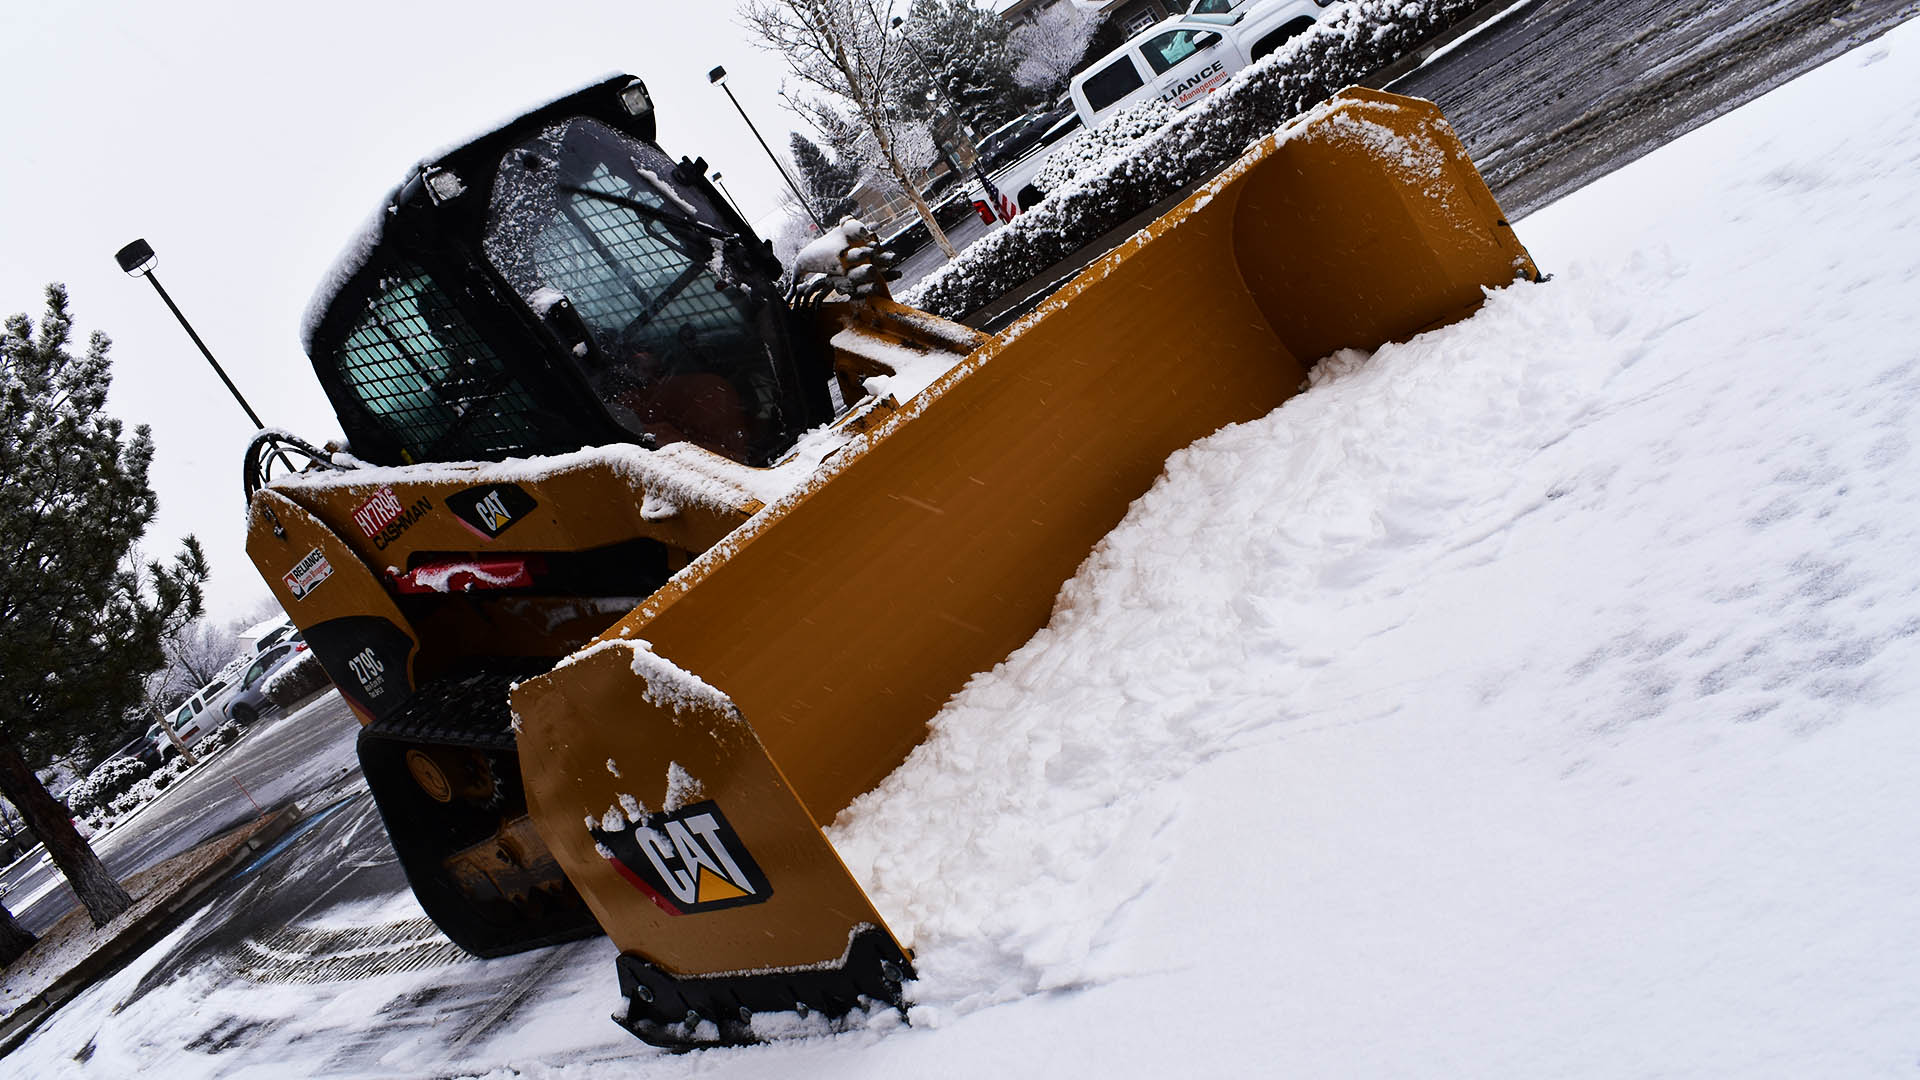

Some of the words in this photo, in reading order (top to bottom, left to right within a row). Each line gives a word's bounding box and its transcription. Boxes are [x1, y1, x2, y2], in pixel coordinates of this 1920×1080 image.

[1179, 71, 1227, 103] Management
[354, 489, 402, 537] HY7R96
[373, 496, 432, 550] CASHMAN
[476, 490, 512, 531] CAT
[292, 549, 323, 579] RELIANCE
[349, 648, 384, 685] 279C
[635, 814, 756, 904] CAT
